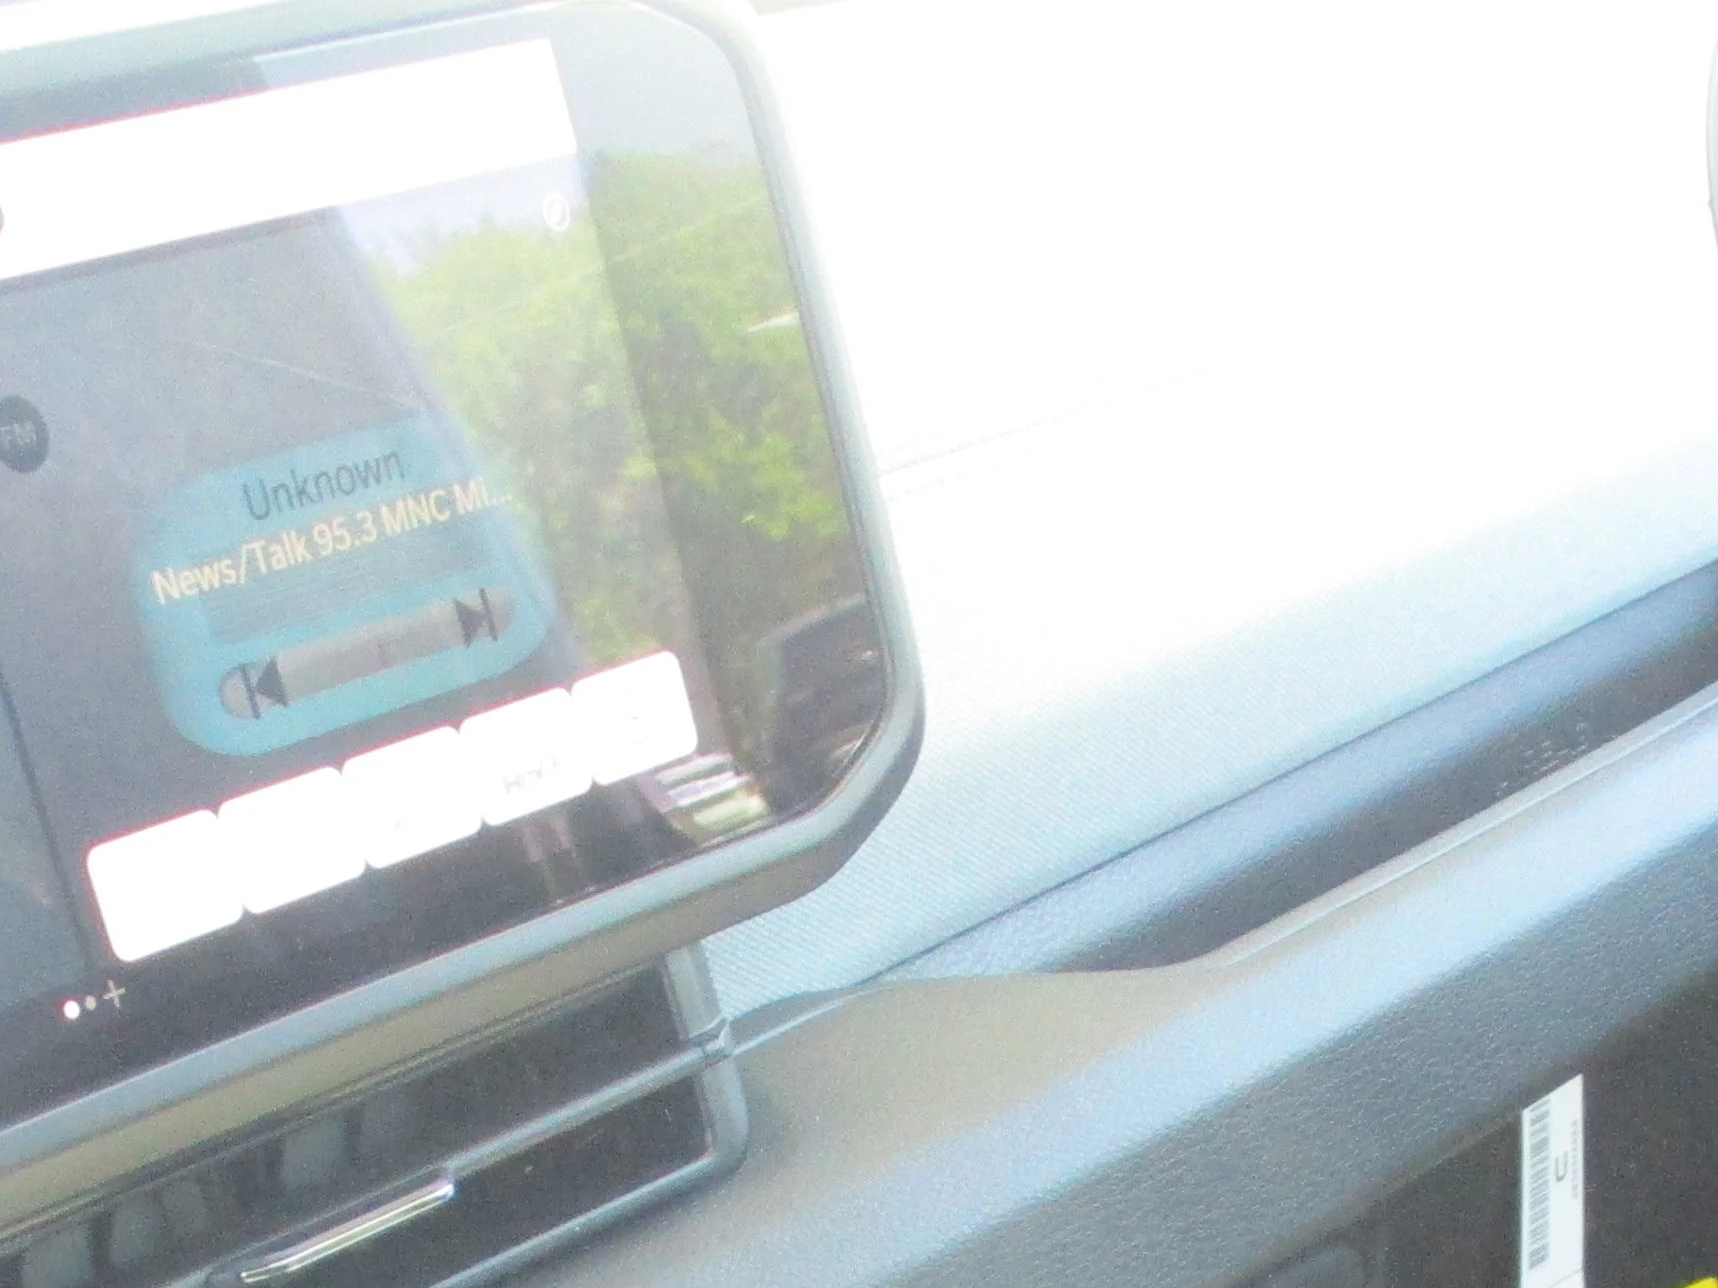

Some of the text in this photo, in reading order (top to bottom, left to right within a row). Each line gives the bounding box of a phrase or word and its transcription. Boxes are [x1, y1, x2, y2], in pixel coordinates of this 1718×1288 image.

[242, 450, 406, 521] Unknown
[150, 529, 313, 605] News/Talk
[312, 511, 379, 556] 95.3
[380, 489, 451, 538] MNC
